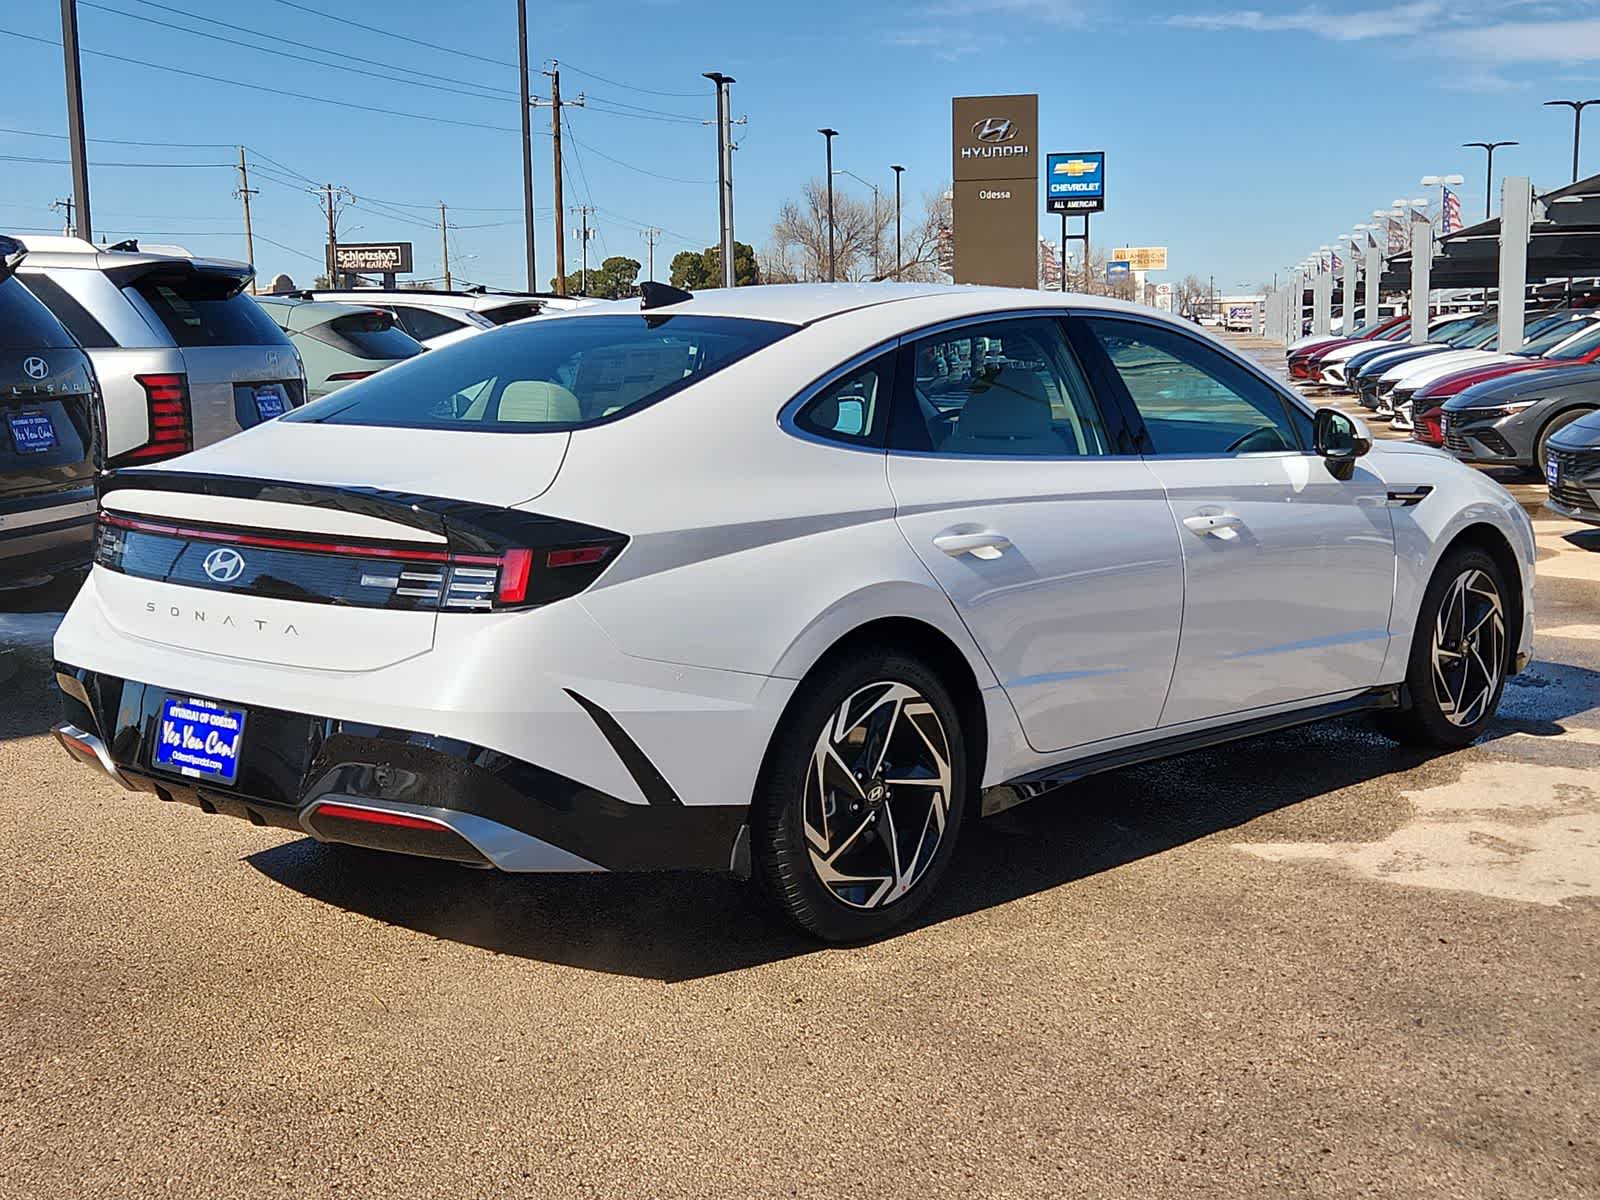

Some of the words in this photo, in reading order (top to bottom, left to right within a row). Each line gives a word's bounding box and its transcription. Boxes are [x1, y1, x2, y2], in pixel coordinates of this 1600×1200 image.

[961, 145, 1029, 159] HYUNDAI
[1051, 182, 1100, 192] CHEVROLET
[979, 190, 1011, 199] Odessa
[1054, 201, 1065, 209] ALL
[1067, 200, 1098, 209] AMERICAN
[337, 250, 397, 263] Schlotzsky's
[146, 602, 298, 635] SONATA
[163, 720, 180, 746] Yes
[182, 725, 204, 750] You
[205, 730, 239, 758] Can!
